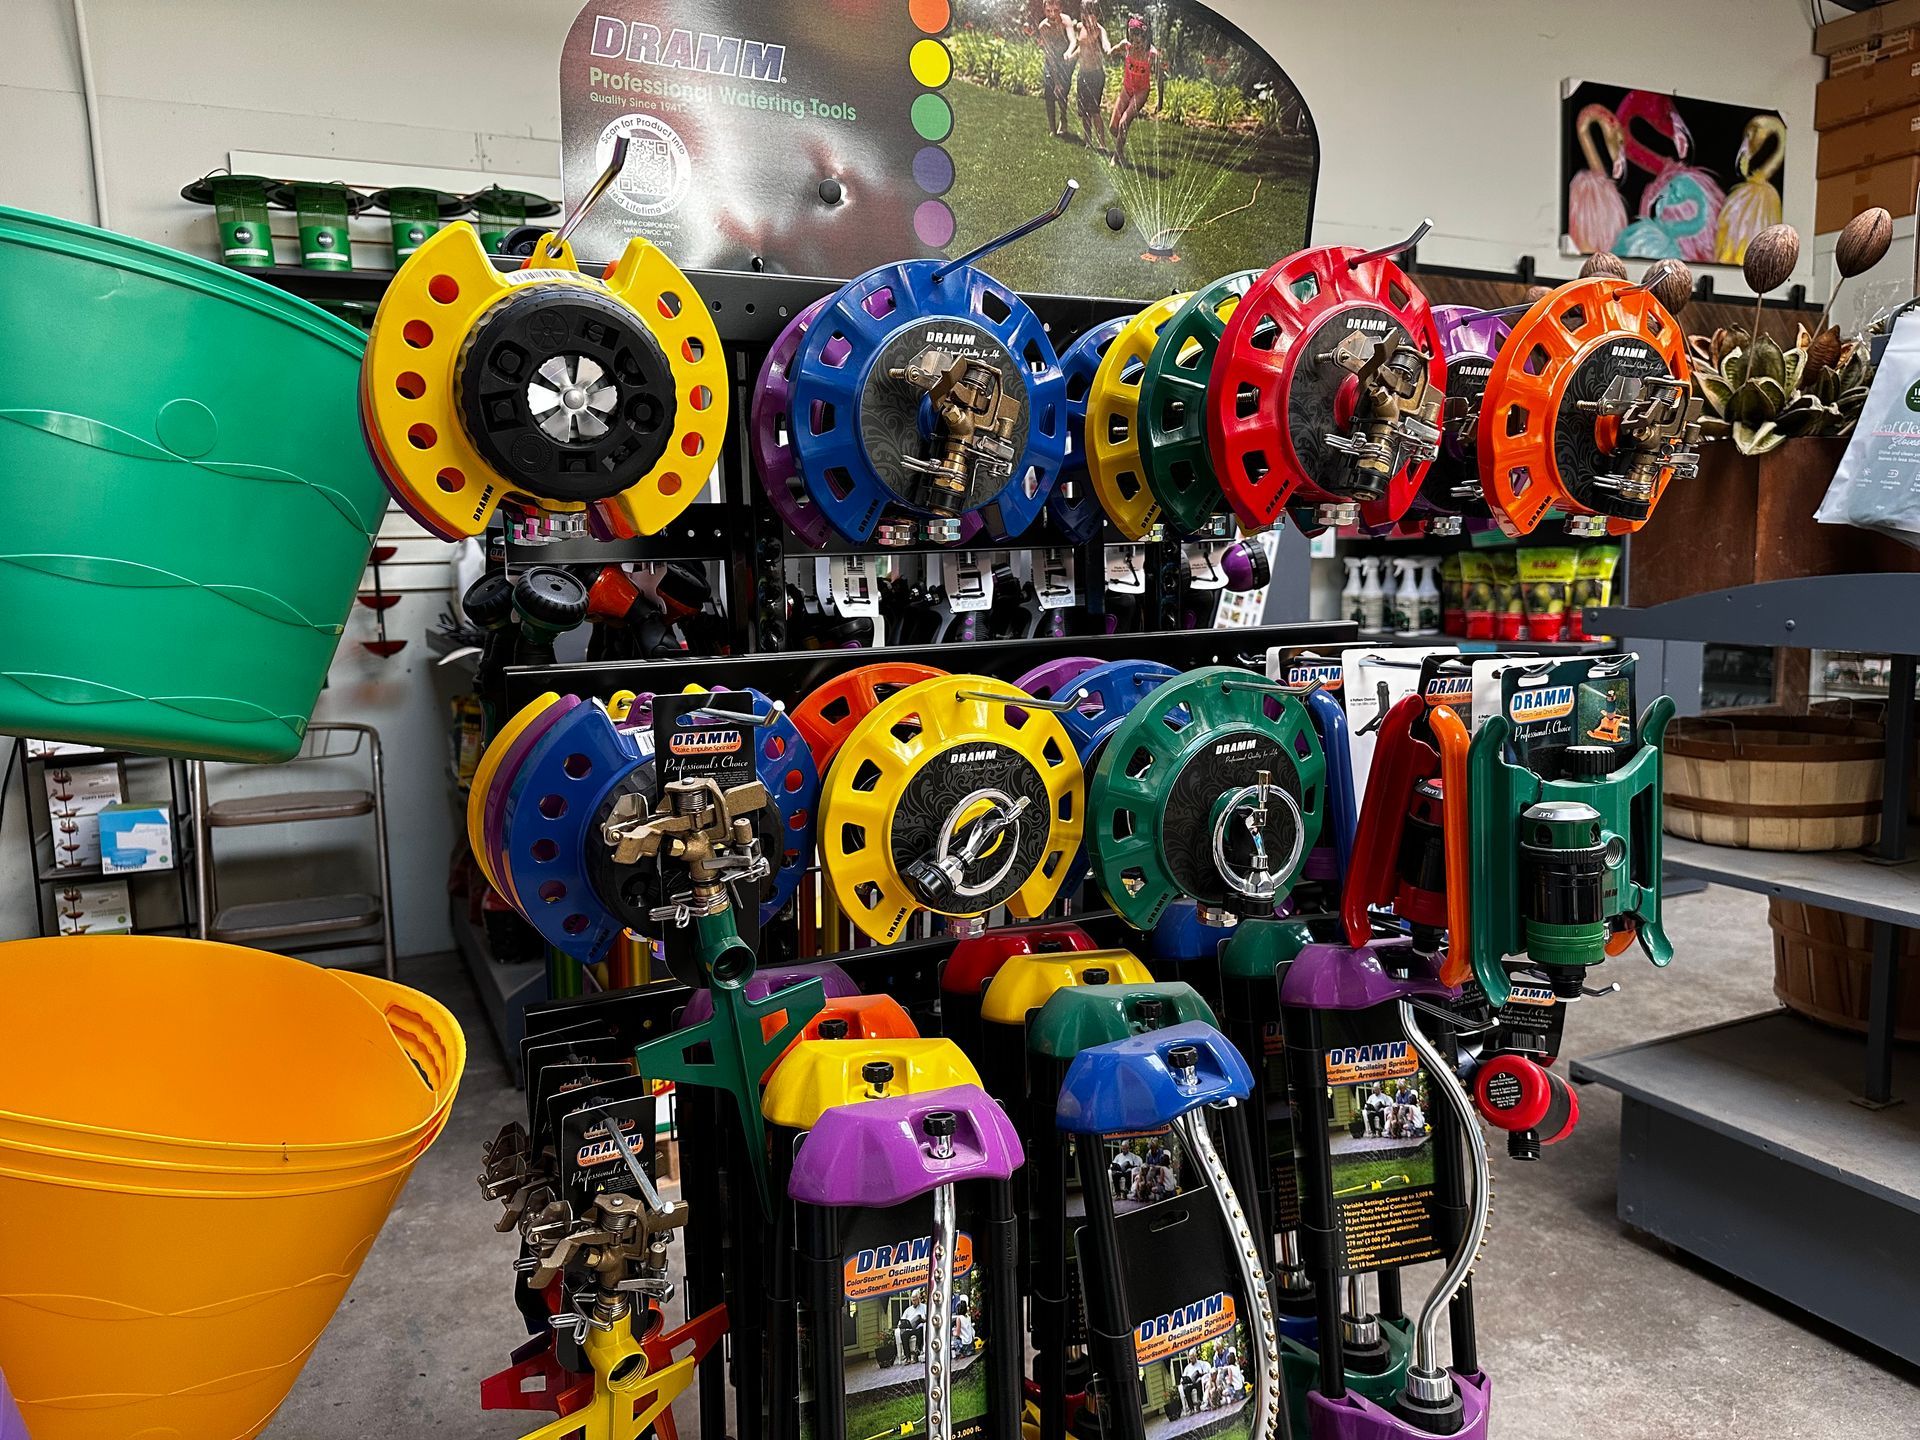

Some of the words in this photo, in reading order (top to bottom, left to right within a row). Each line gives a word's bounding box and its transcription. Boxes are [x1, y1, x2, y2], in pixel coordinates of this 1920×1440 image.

[590, 67, 713, 98] Professional
[719, 86, 805, 119] Watering
[810, 98, 857, 121] Tools
[590, 91, 627, 107] Quality
[629, 95, 656, 110] Since
[601, 124, 621, 144] Scan
[621, 118, 633, 128] for
[637, 118, 672, 138] Product
[672, 135, 685, 155] Info
[1346, 318, 1387, 331] DRAMM
[926, 331, 976, 345] DRAMM
[1611, 346, 1648, 359] DRAMM
[473, 484, 494, 522] DRAMM
[1266, 479, 1290, 515] DRAMM
[1527, 495, 1552, 527] DRAMM
[1512, 687, 1573, 711] DRAMM
[1552, 706, 1571, 715] Sprinkler
[673, 731, 740, 746] DRAMM
[1514, 723, 1551, 742] Professional's
[1552, 720, 1572, 734] Choice
[674, 746, 690, 754] Stake
[691, 745, 713, 753] Impulse
[713, 744, 738, 752] Sprinkler
[1215, 739, 1257, 755] DRAMM
[664, 756, 719, 776] Professional's
[721, 755, 749, 769] Choice
[950, 750, 997, 764] DRAMM
[1538, 810, 1555, 819] FLAT
[104, 864, 119, 872] Bird
[119, 863, 144, 871] Feeder
[887, 906, 908, 938] DRAMM
[1512, 986, 1553, 999] RAMM
[1330, 1041, 1407, 1067] DRAMM
[1355, 1063, 1387, 1072] Oscillating
[1388, 1059, 1417, 1068] Sprinkler
[1358, 1071, 1387, 1079] Arroseur
[1388, 1067, 1415, 1075] Oscillant
[579, 1133, 641, 1158] DRAM
[571, 1161, 621, 1191] Professional's
[1342, 1202, 1364, 1210] Variable
[1364, 1199, 1385, 1207] Settings
[1415, 1191, 1429, 1199] 3,000
[1343, 1208, 1374, 1217] Heavy-Duty
[1390, 1200, 1422, 1210] Construction
[1345, 1223, 1376, 1232] Paramètres
[1403, 1214, 1430, 1223] couverture
[1351, 1217, 1360, 1225] Jet
[1402, 1207, 1426, 1216] Watering
[1356, 1230, 1375, 1238] surface
[1375, 1227, 1396, 1236] pouvant
[1396, 1223, 1419, 1231] atteindre
[1347, 1245, 1381, 1255] Construction
[1381, 1241, 1402, 1250] durable,
[1402, 1235, 1433, 1245] entièrement
[1347, 1253, 1375, 1262] métallique
[1381, 1256, 1402, 1264] assurent
[1409, 1251, 1431, 1259] arrosage
[888, 1263, 930, 1278] Oscillating
[892, 1272, 929, 1287] Arroseur
[1140, 1292, 1223, 1342] DRAMM
[1168, 1324, 1203, 1342] Oscillating
[1204, 1311, 1234, 1328] Sprinkler
[1172, 1333, 1203, 1349] Arroseur
[1204, 1320, 1232, 1337] Oscillant
[957, 1428, 975, 1439] 3,000
[975, 1425, 983, 1434] ft.
